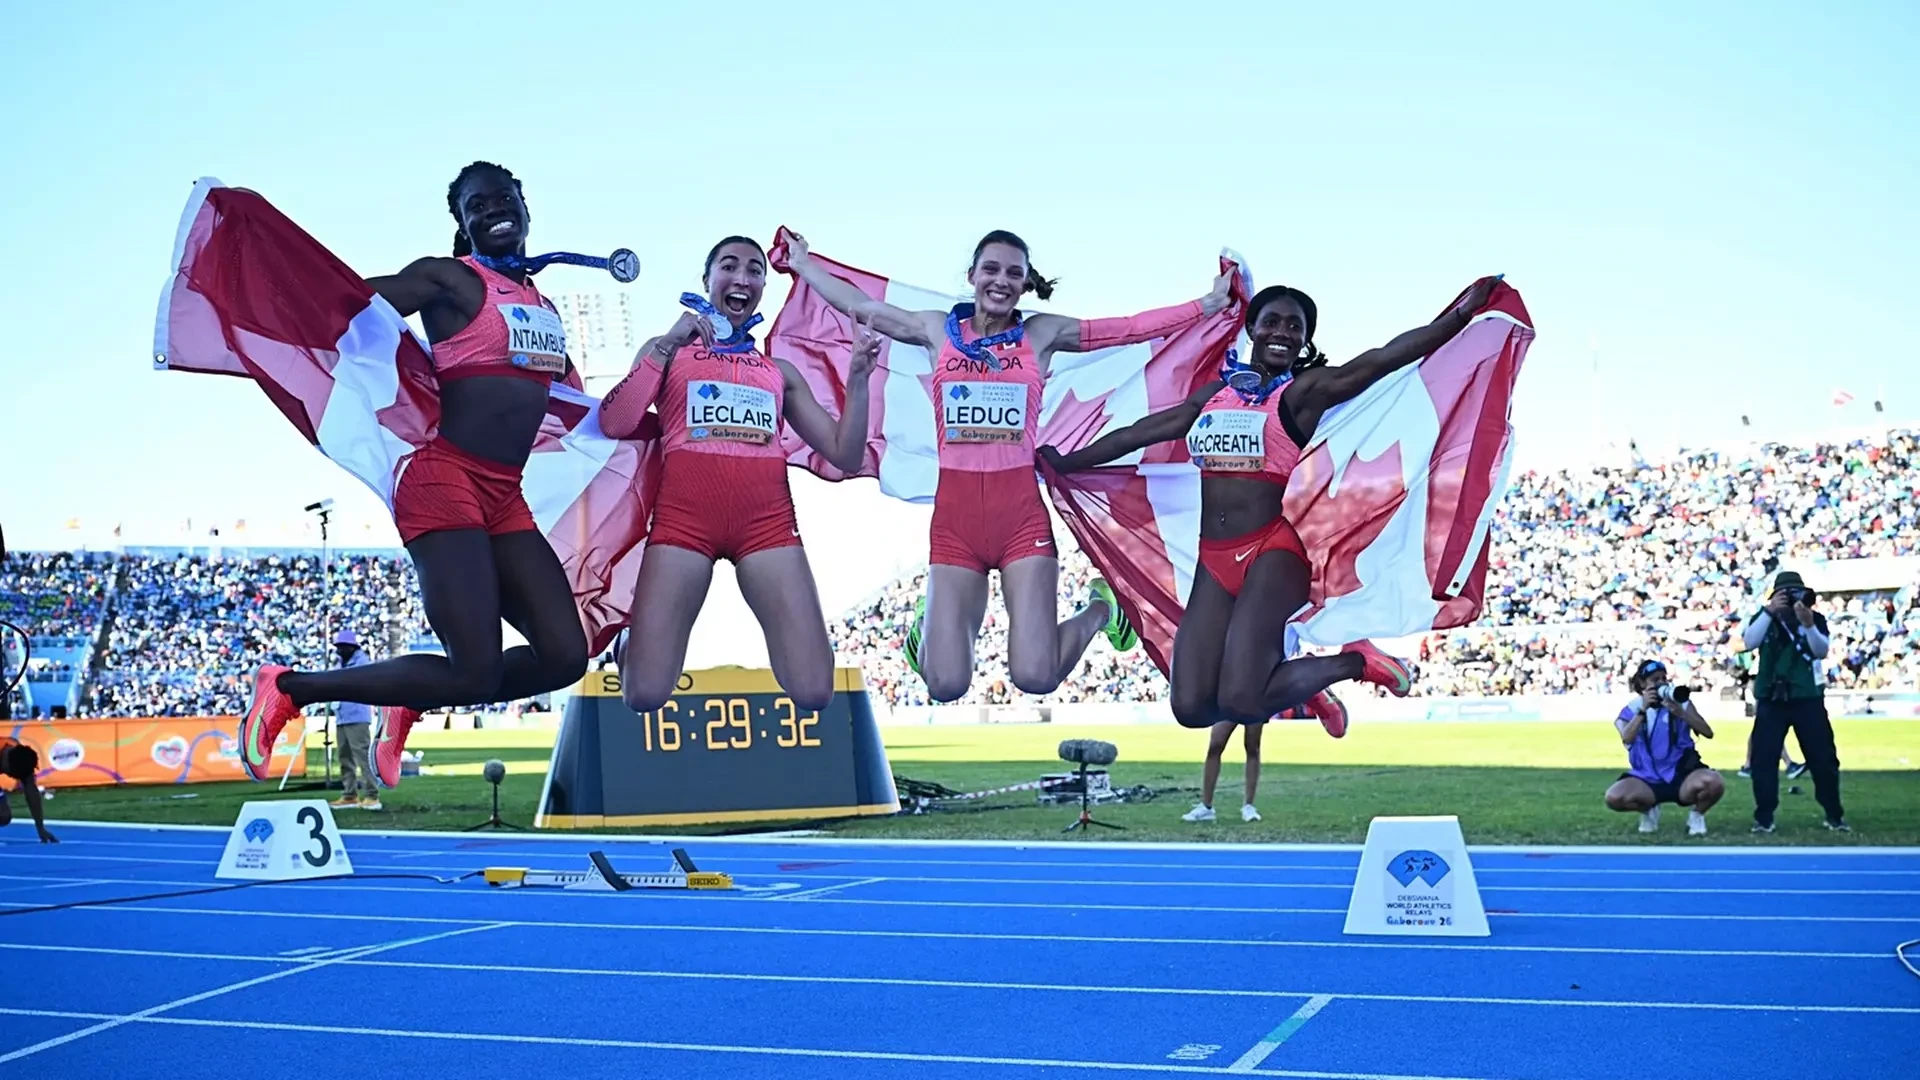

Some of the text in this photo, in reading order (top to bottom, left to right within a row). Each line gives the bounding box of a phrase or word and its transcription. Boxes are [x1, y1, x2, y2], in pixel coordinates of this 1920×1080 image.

[945, 356, 1024, 374] CANDA
[692, 405, 773, 429] LECLAIR
[946, 406, 1020, 426] LEDUC
[1189, 434, 1260, 453] McCREATH
[643, 697, 822, 751] 16:29:32
[296, 806, 332, 868] 3
[689, 877, 720, 886] SEIKO
[1439, 916, 1452, 926] 26
